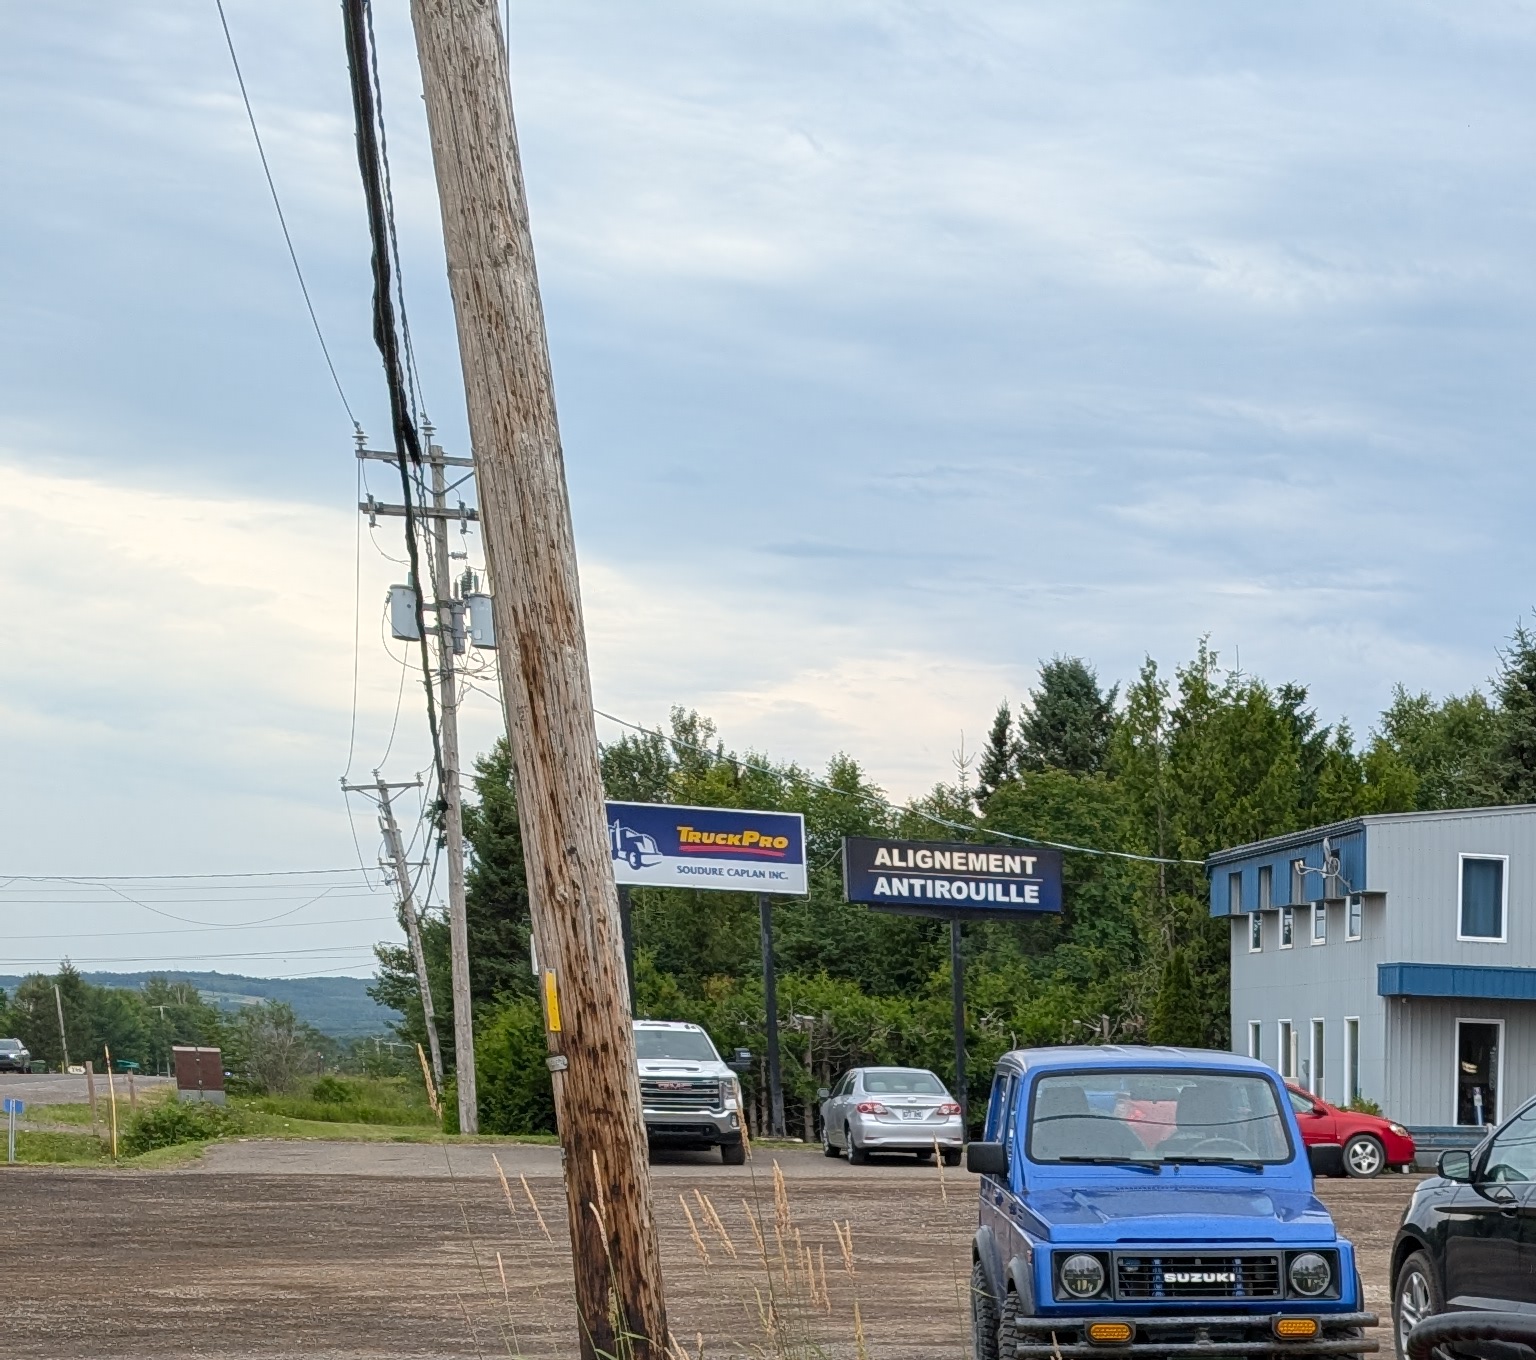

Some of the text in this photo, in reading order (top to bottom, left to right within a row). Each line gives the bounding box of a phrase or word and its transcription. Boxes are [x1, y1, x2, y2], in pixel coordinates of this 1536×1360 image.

[874, 847, 1038, 875] ALIGNEMENT
[676, 865, 789, 880] SOUDURE CAPLAN INC.
[873, 877, 1040, 904] ANTIROUILLE
[1164, 1272, 1236, 1283] SUZUKI
